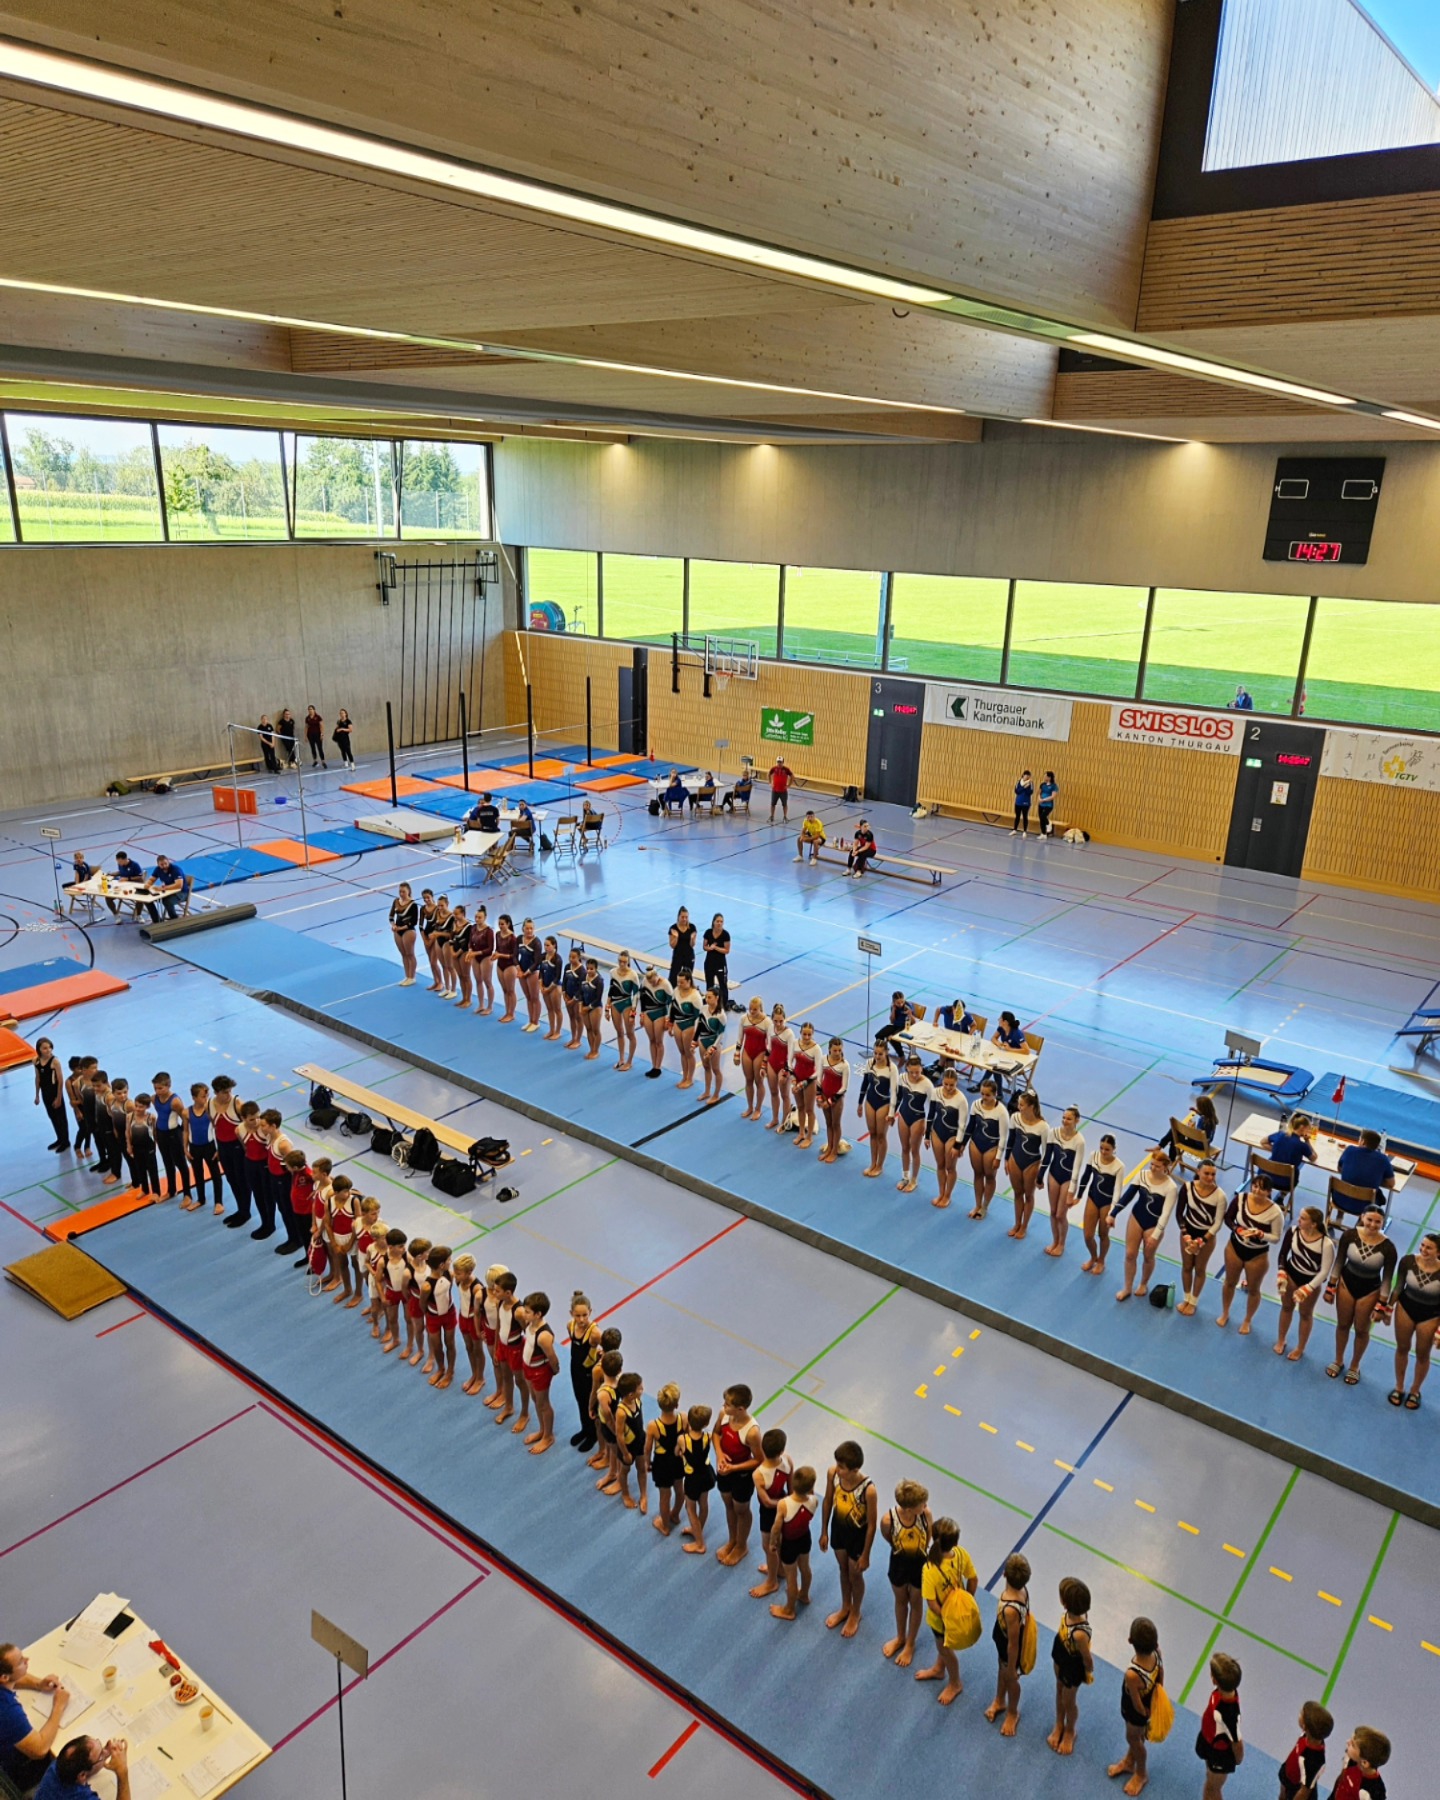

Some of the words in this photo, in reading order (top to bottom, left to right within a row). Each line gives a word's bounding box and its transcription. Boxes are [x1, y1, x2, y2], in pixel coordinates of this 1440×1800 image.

[1295, 543, 1340, 561] 14:27
[875, 682, 882, 694] 3
[974, 698, 1027, 716] Thurgauer
[973, 710, 1045, 730] Kantonalbank
[1119, 708, 1234, 740] SWISSLOS
[1117, 731, 1164, 744] KANTON
[1170, 738, 1231, 752] THURGAU
[1250, 727, 1261, 741] 2
